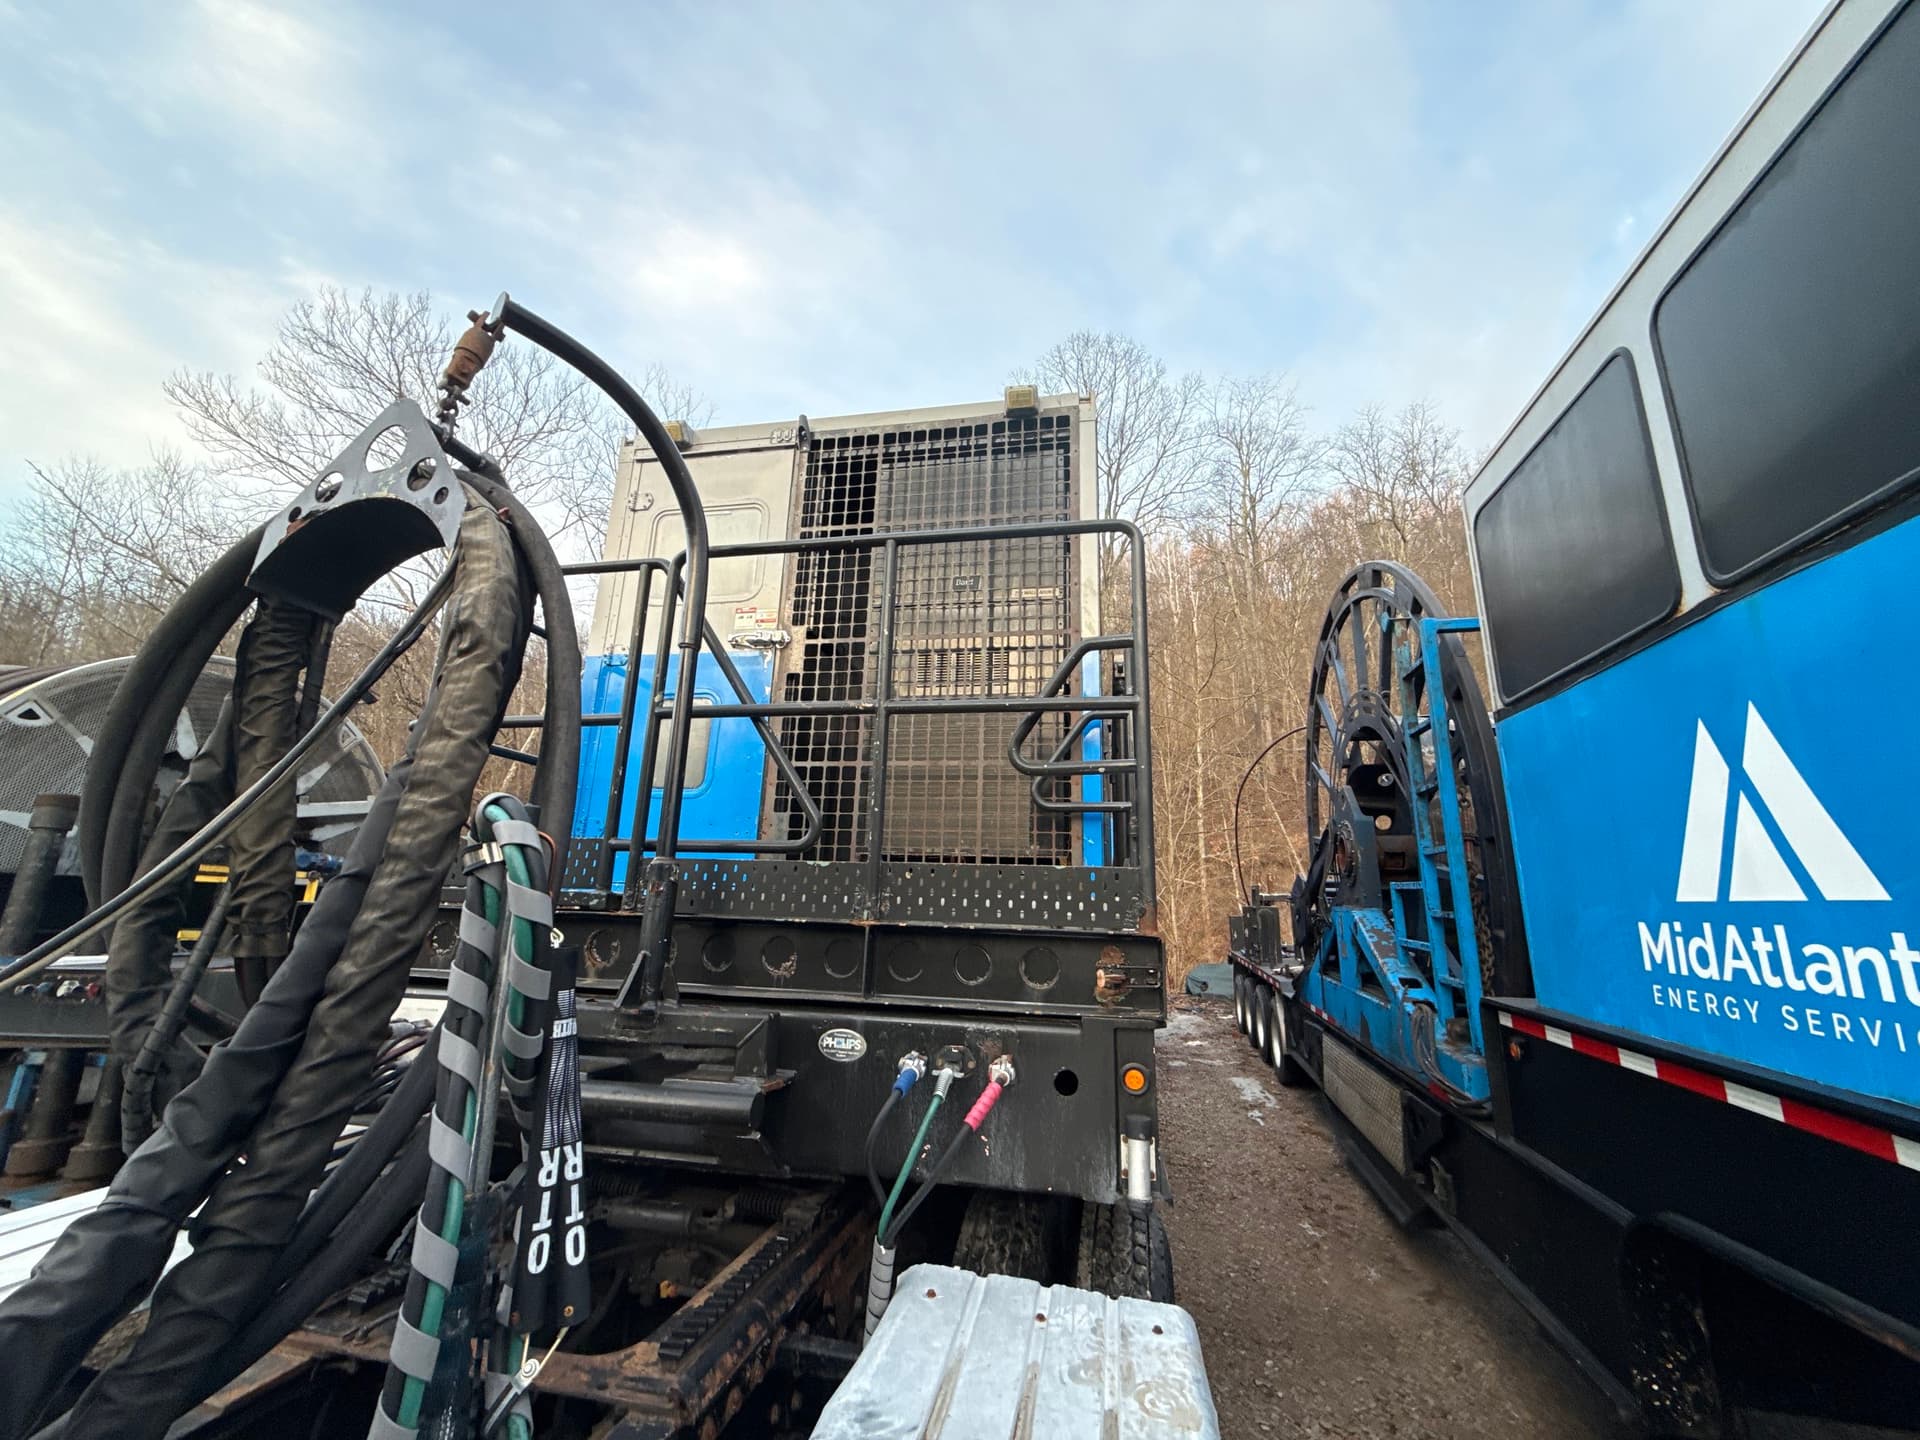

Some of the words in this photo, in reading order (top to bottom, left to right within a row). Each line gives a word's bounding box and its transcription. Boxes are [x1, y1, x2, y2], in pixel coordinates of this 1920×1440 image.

[1638, 921, 1920, 1007] MidAtlant
[1653, 984, 1759, 1023] ENERGY
[1781, 1005, 1920, 1052] SERVI
